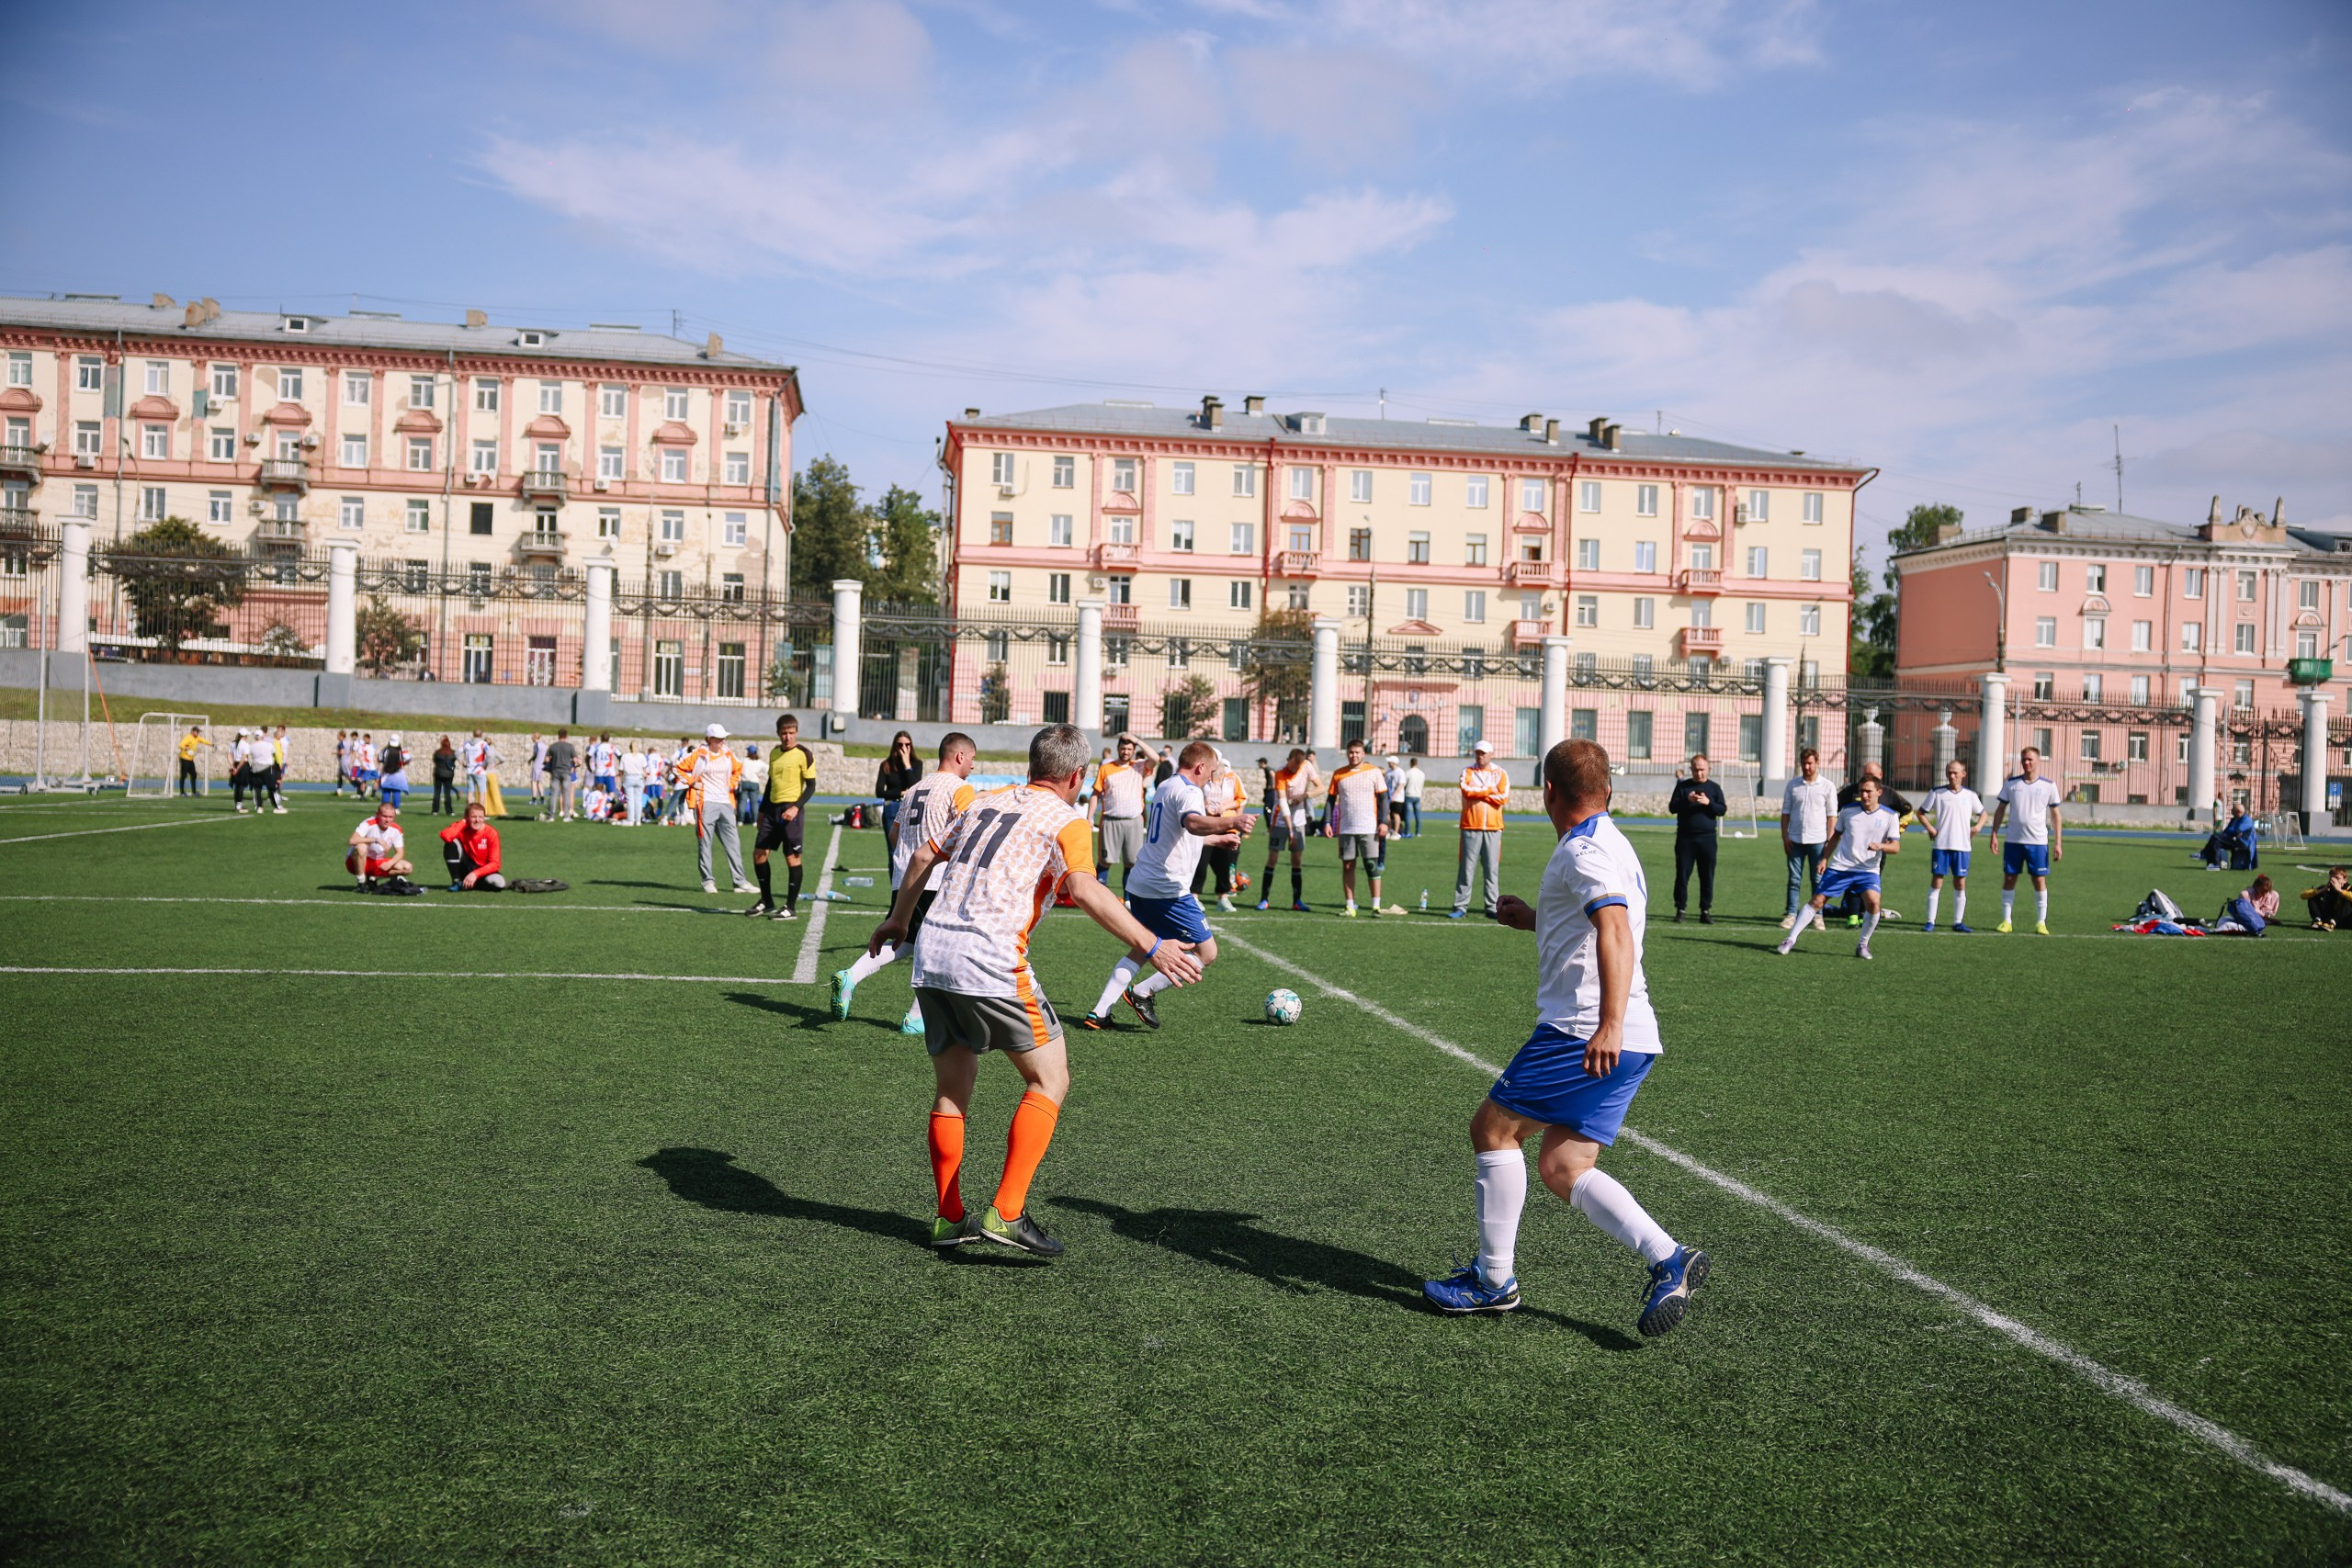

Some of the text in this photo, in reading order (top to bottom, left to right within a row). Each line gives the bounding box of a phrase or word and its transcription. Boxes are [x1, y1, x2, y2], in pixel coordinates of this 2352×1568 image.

[910, 789, 932, 826] 5
[957, 807, 1023, 869] 11
[1575, 850, 1598, 858] KELME
